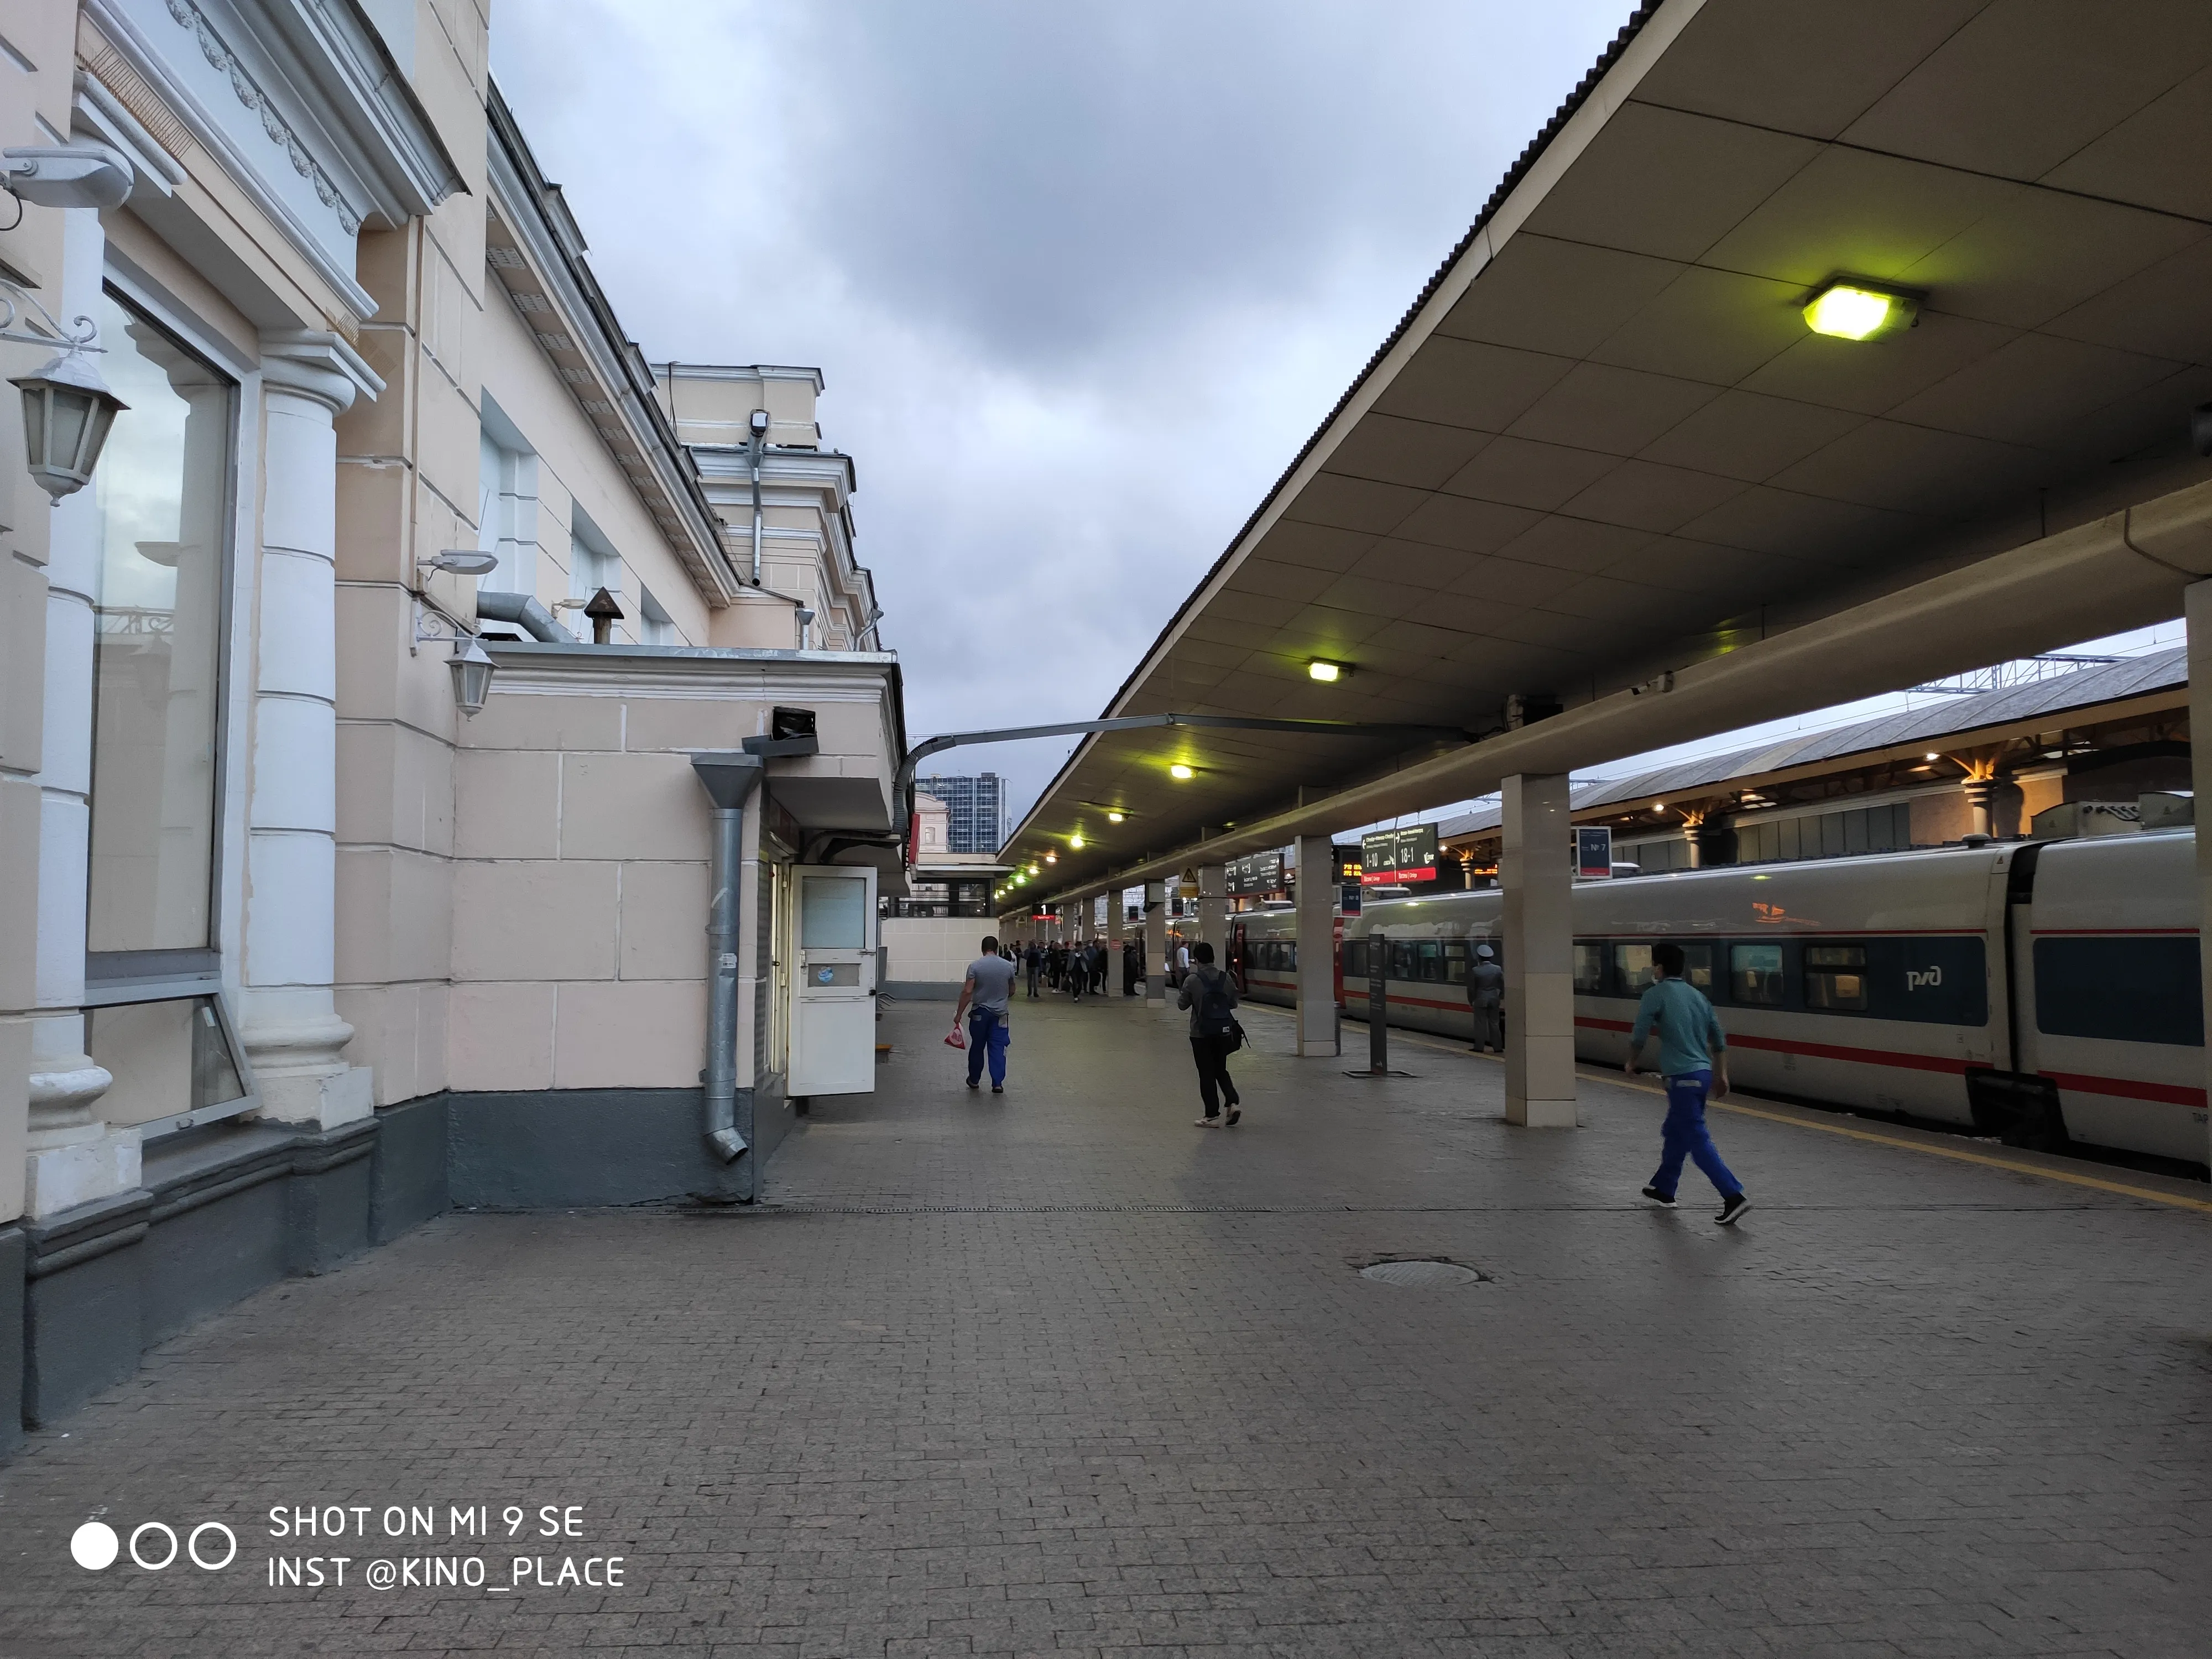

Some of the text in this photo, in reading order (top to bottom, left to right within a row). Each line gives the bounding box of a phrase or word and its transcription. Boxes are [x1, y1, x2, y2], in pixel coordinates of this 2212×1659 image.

[1366, 852, 1379, 868] 1-10
[1400, 847, 1414, 863] 18-1
[1041, 904, 1046, 915] 1
